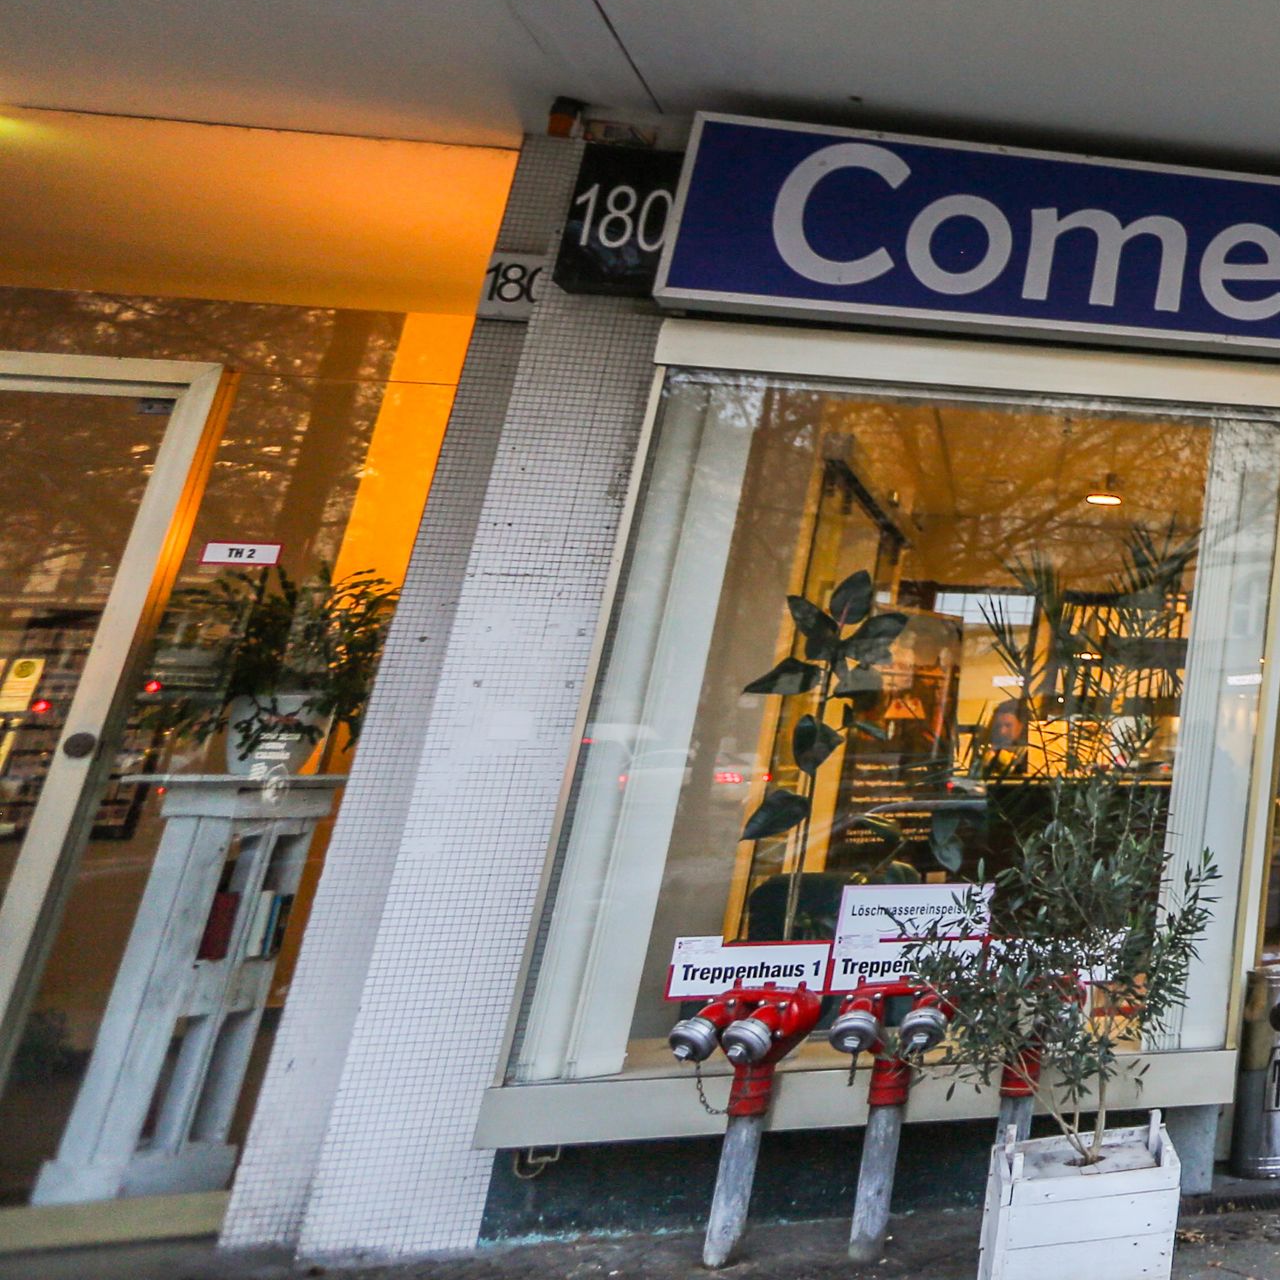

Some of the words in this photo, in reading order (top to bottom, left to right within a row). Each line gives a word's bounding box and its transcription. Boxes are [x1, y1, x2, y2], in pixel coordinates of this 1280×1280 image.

[575, 183, 674, 253] 180
[228, 548, 245, 559] TH
[246, 548, 256, 559] 2
[682, 961, 805, 984] Treppenhaus
[812, 960, 821, 977] 1
